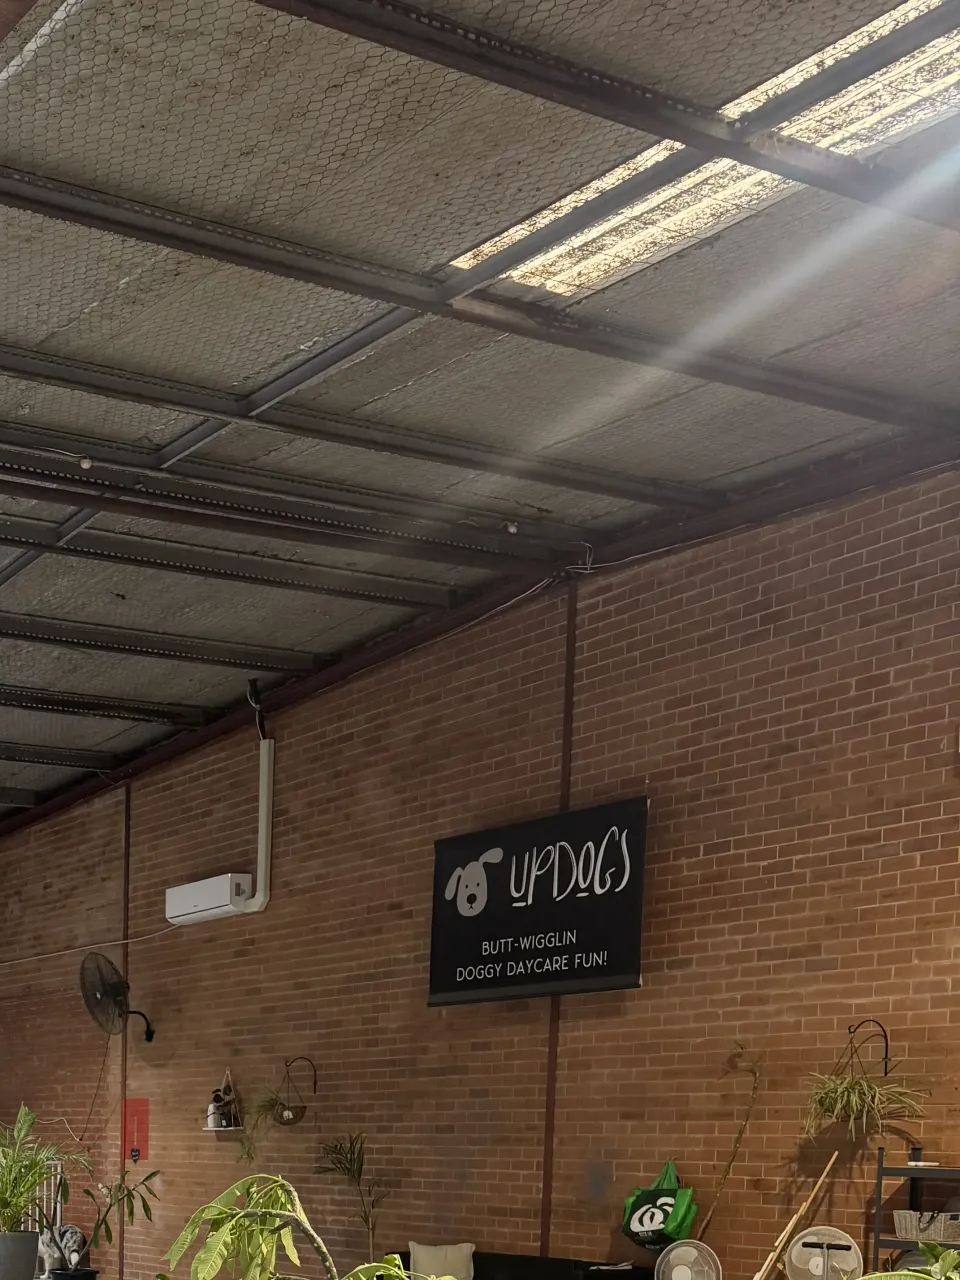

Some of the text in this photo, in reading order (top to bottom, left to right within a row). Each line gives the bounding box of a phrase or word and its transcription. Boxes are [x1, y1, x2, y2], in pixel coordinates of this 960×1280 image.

[510, 826, 631, 907] UPDOGS
[482, 929, 577, 956] BUTT-WIGGLIN
[456, 950, 608, 982] DOGGY DAYCARE FUN!
